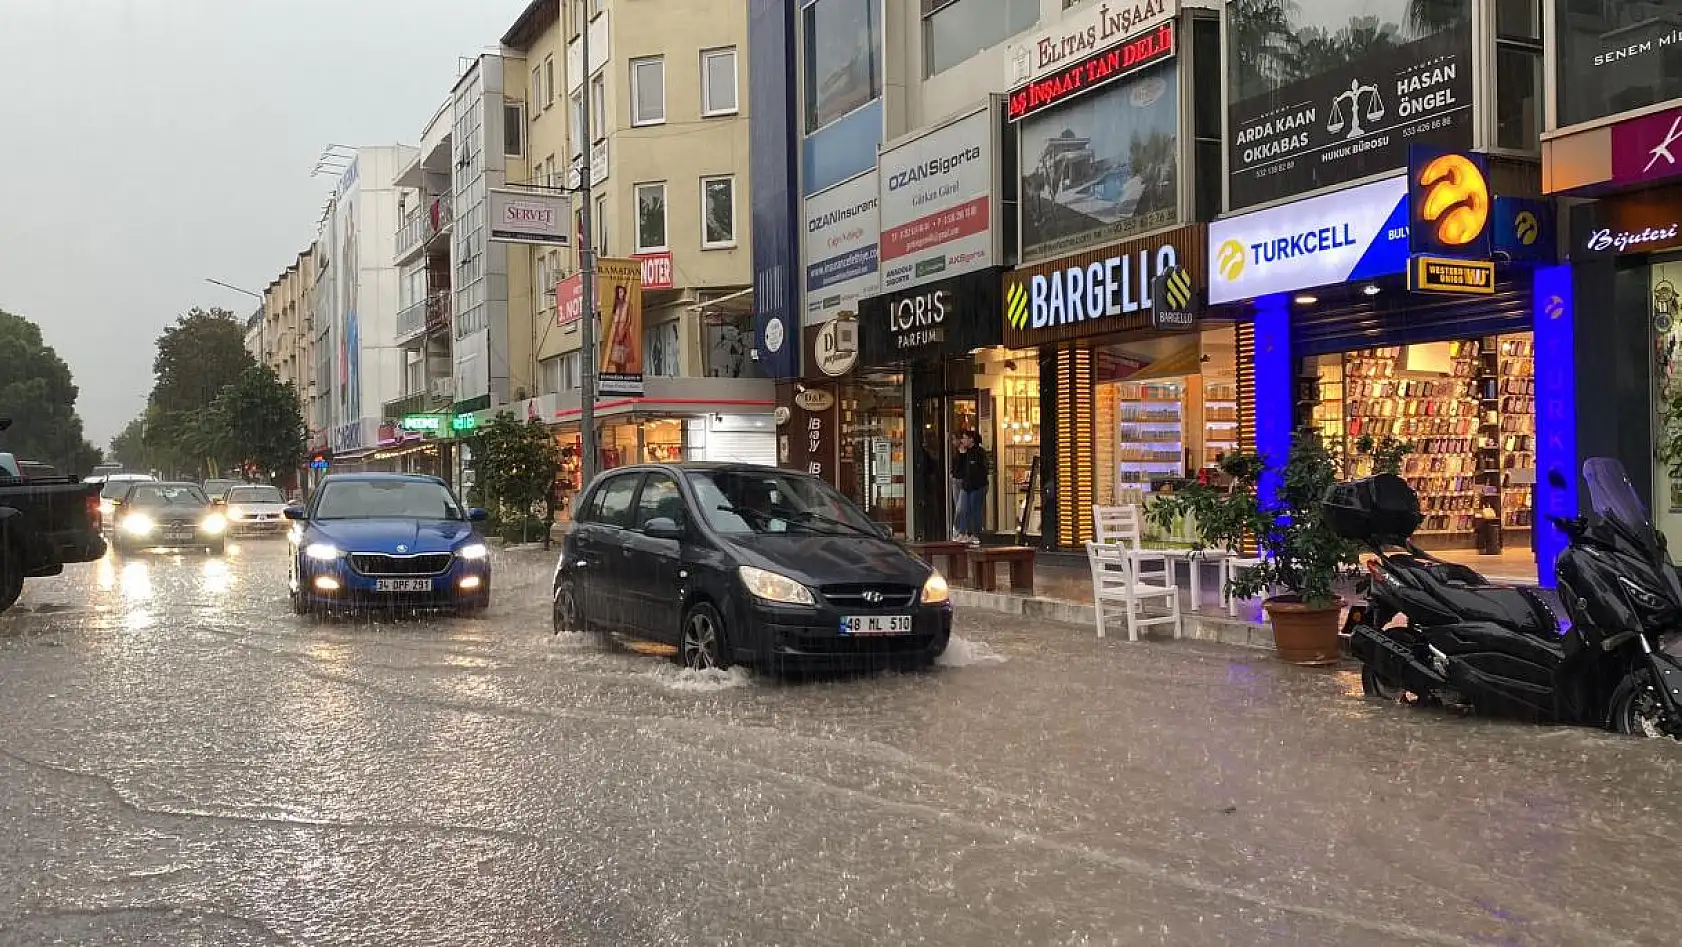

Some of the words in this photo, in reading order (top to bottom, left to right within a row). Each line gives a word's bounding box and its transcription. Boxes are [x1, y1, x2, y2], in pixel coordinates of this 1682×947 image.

[1086, 50, 1121, 81] TAN
[1594, 40, 1651, 66] SENEM
[1397, 64, 1456, 96] HASAN
[1399, 88, 1457, 117] ÖNGEL
[1236, 122, 1273, 146] ARDA
[1275, 108, 1316, 133] KAAN
[1243, 132, 1309, 163] OKKABAS
[1322, 146, 1352, 163] HUKUK
[1352, 136, 1389, 154] BÜROSU
[889, 145, 980, 192] OZANSigorta
[507, 207, 553, 222] SERVET
[1251, 222, 1357, 266] TURKCELL
[1587, 223, 1679, 252] Bijuteri
[641, 258, 671, 286] NOTER
[1429, 265, 1463, 275] WESTERN
[890, 290, 944, 332] LORIS
[1159, 311, 1193, 324] BARGELLO
[898, 330, 936, 349] PARFUM
[378, 580, 389, 589] 34
[848, 618, 861, 630] 48
[869, 618, 882, 630] ML
[890, 617, 910, 630] 510
